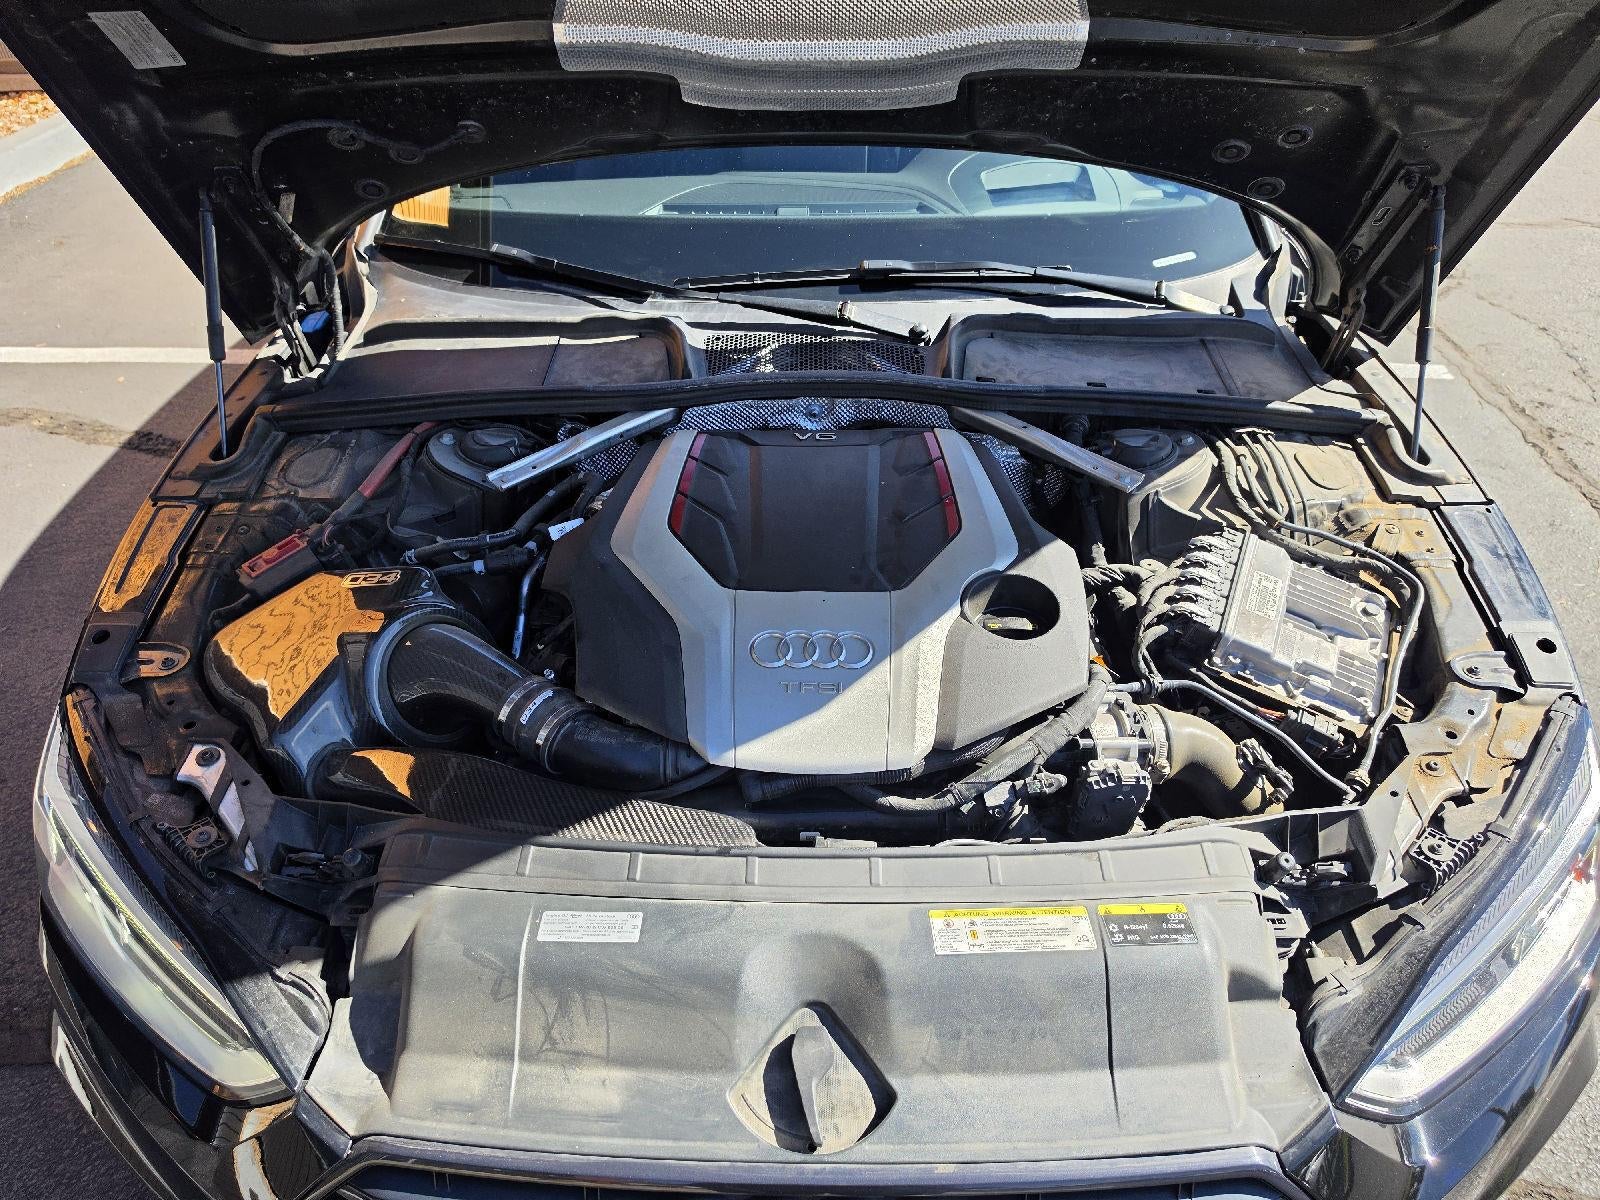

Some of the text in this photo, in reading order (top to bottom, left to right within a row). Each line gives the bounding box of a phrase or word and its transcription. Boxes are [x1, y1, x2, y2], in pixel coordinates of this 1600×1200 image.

[793, 432, 837, 441] V6
[342, 571, 399, 586] 034
[779, 681, 843, 694] TFSI
